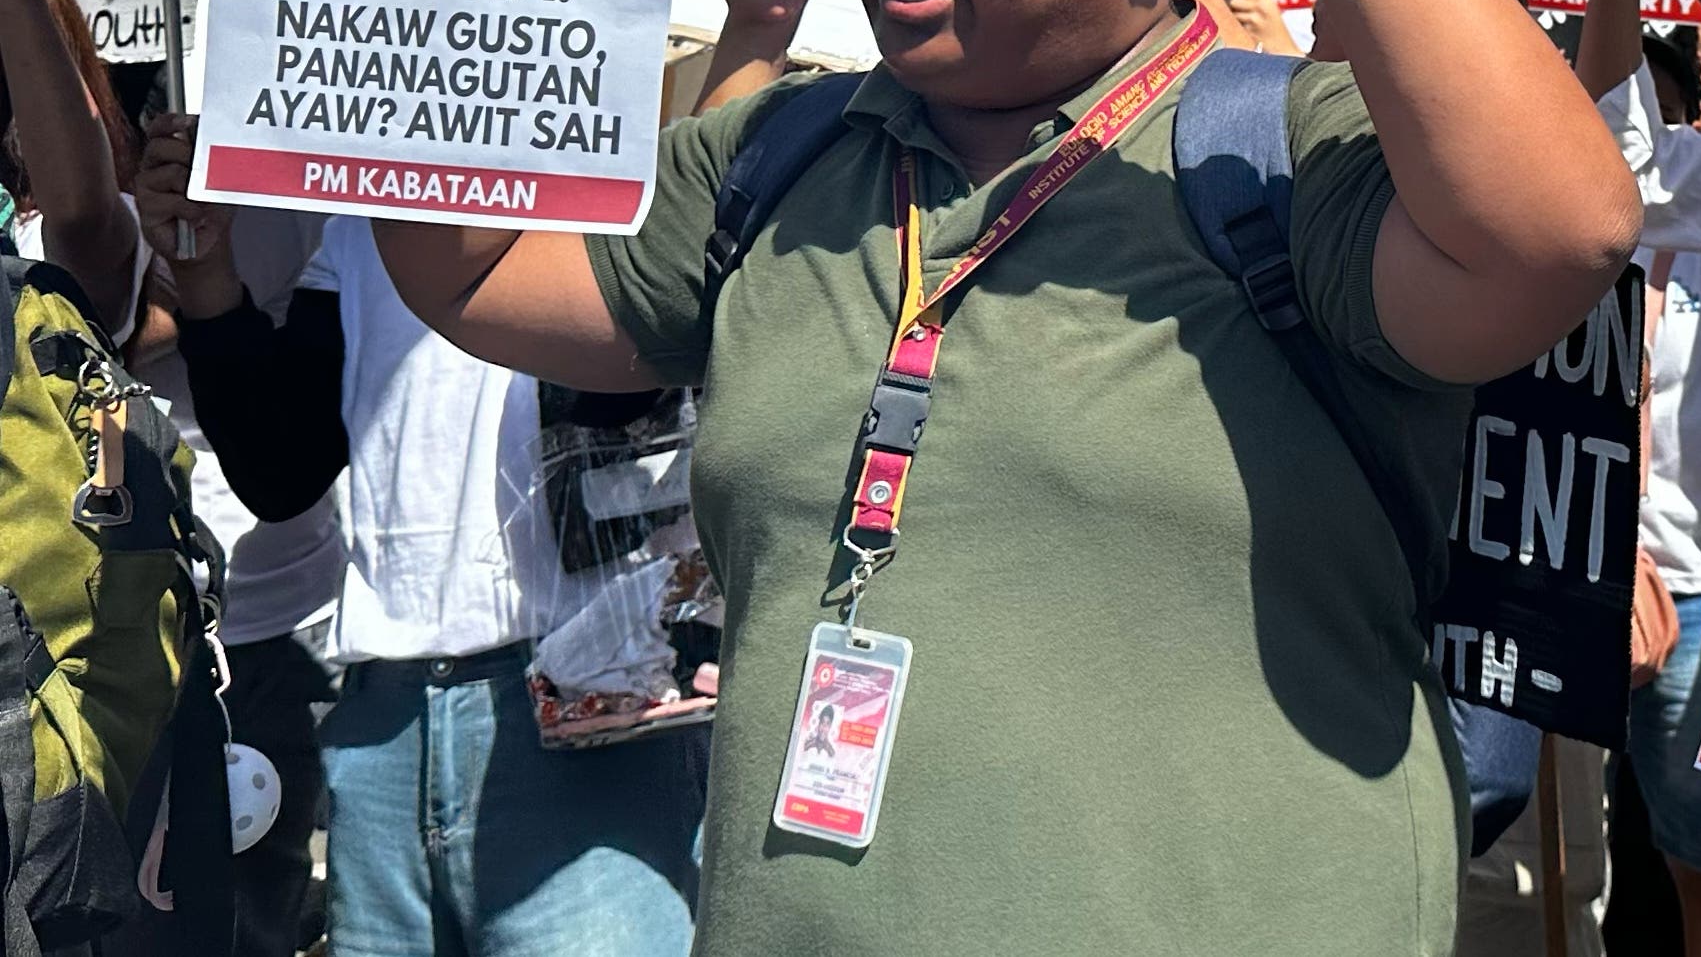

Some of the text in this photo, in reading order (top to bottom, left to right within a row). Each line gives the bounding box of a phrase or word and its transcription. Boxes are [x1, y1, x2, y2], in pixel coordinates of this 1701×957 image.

[276, 0, 607, 67] NAKAW GUSTO,
[276, 45, 600, 107] PANANAGUTAN
[246, 89, 622, 155] AYAW? AWIT SAH
[304, 162, 537, 210] PM KABATAAN
[1028, 142, 1091, 200] INSTITUTE
